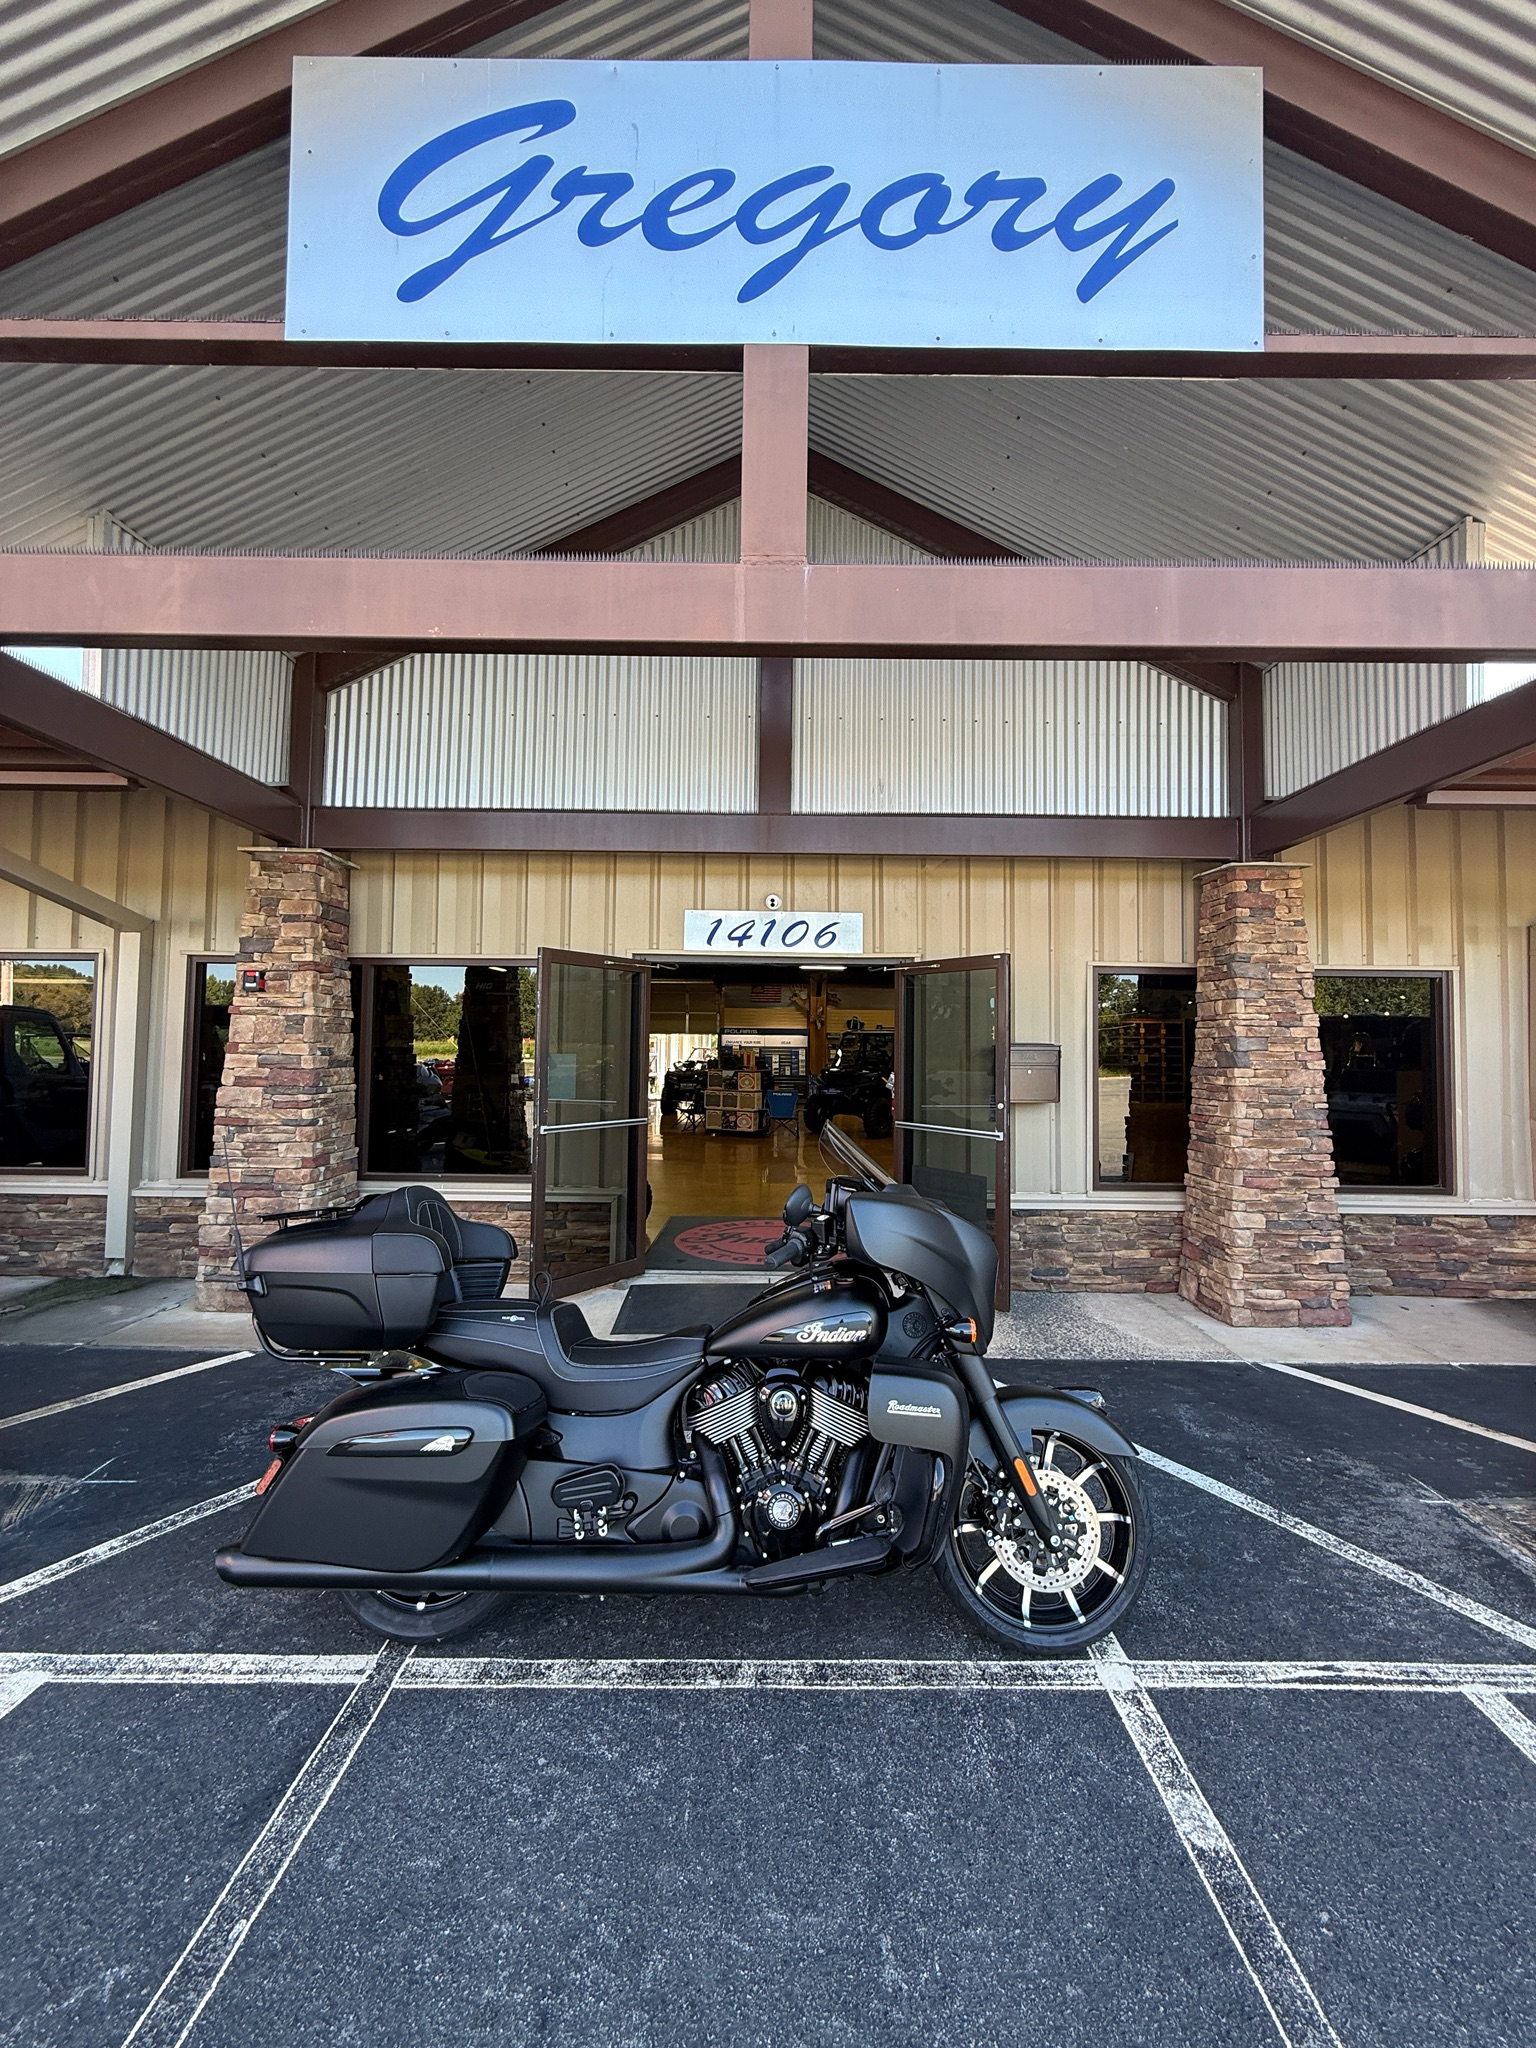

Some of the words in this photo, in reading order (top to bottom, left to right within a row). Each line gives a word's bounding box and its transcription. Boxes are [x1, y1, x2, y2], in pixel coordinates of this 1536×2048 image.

[378, 100, 1179, 303] Gregory
[706, 918, 841, 949] 14106
[796, 1321, 867, 1343] Indian
[887, 1400, 941, 1415] Roadmaster
